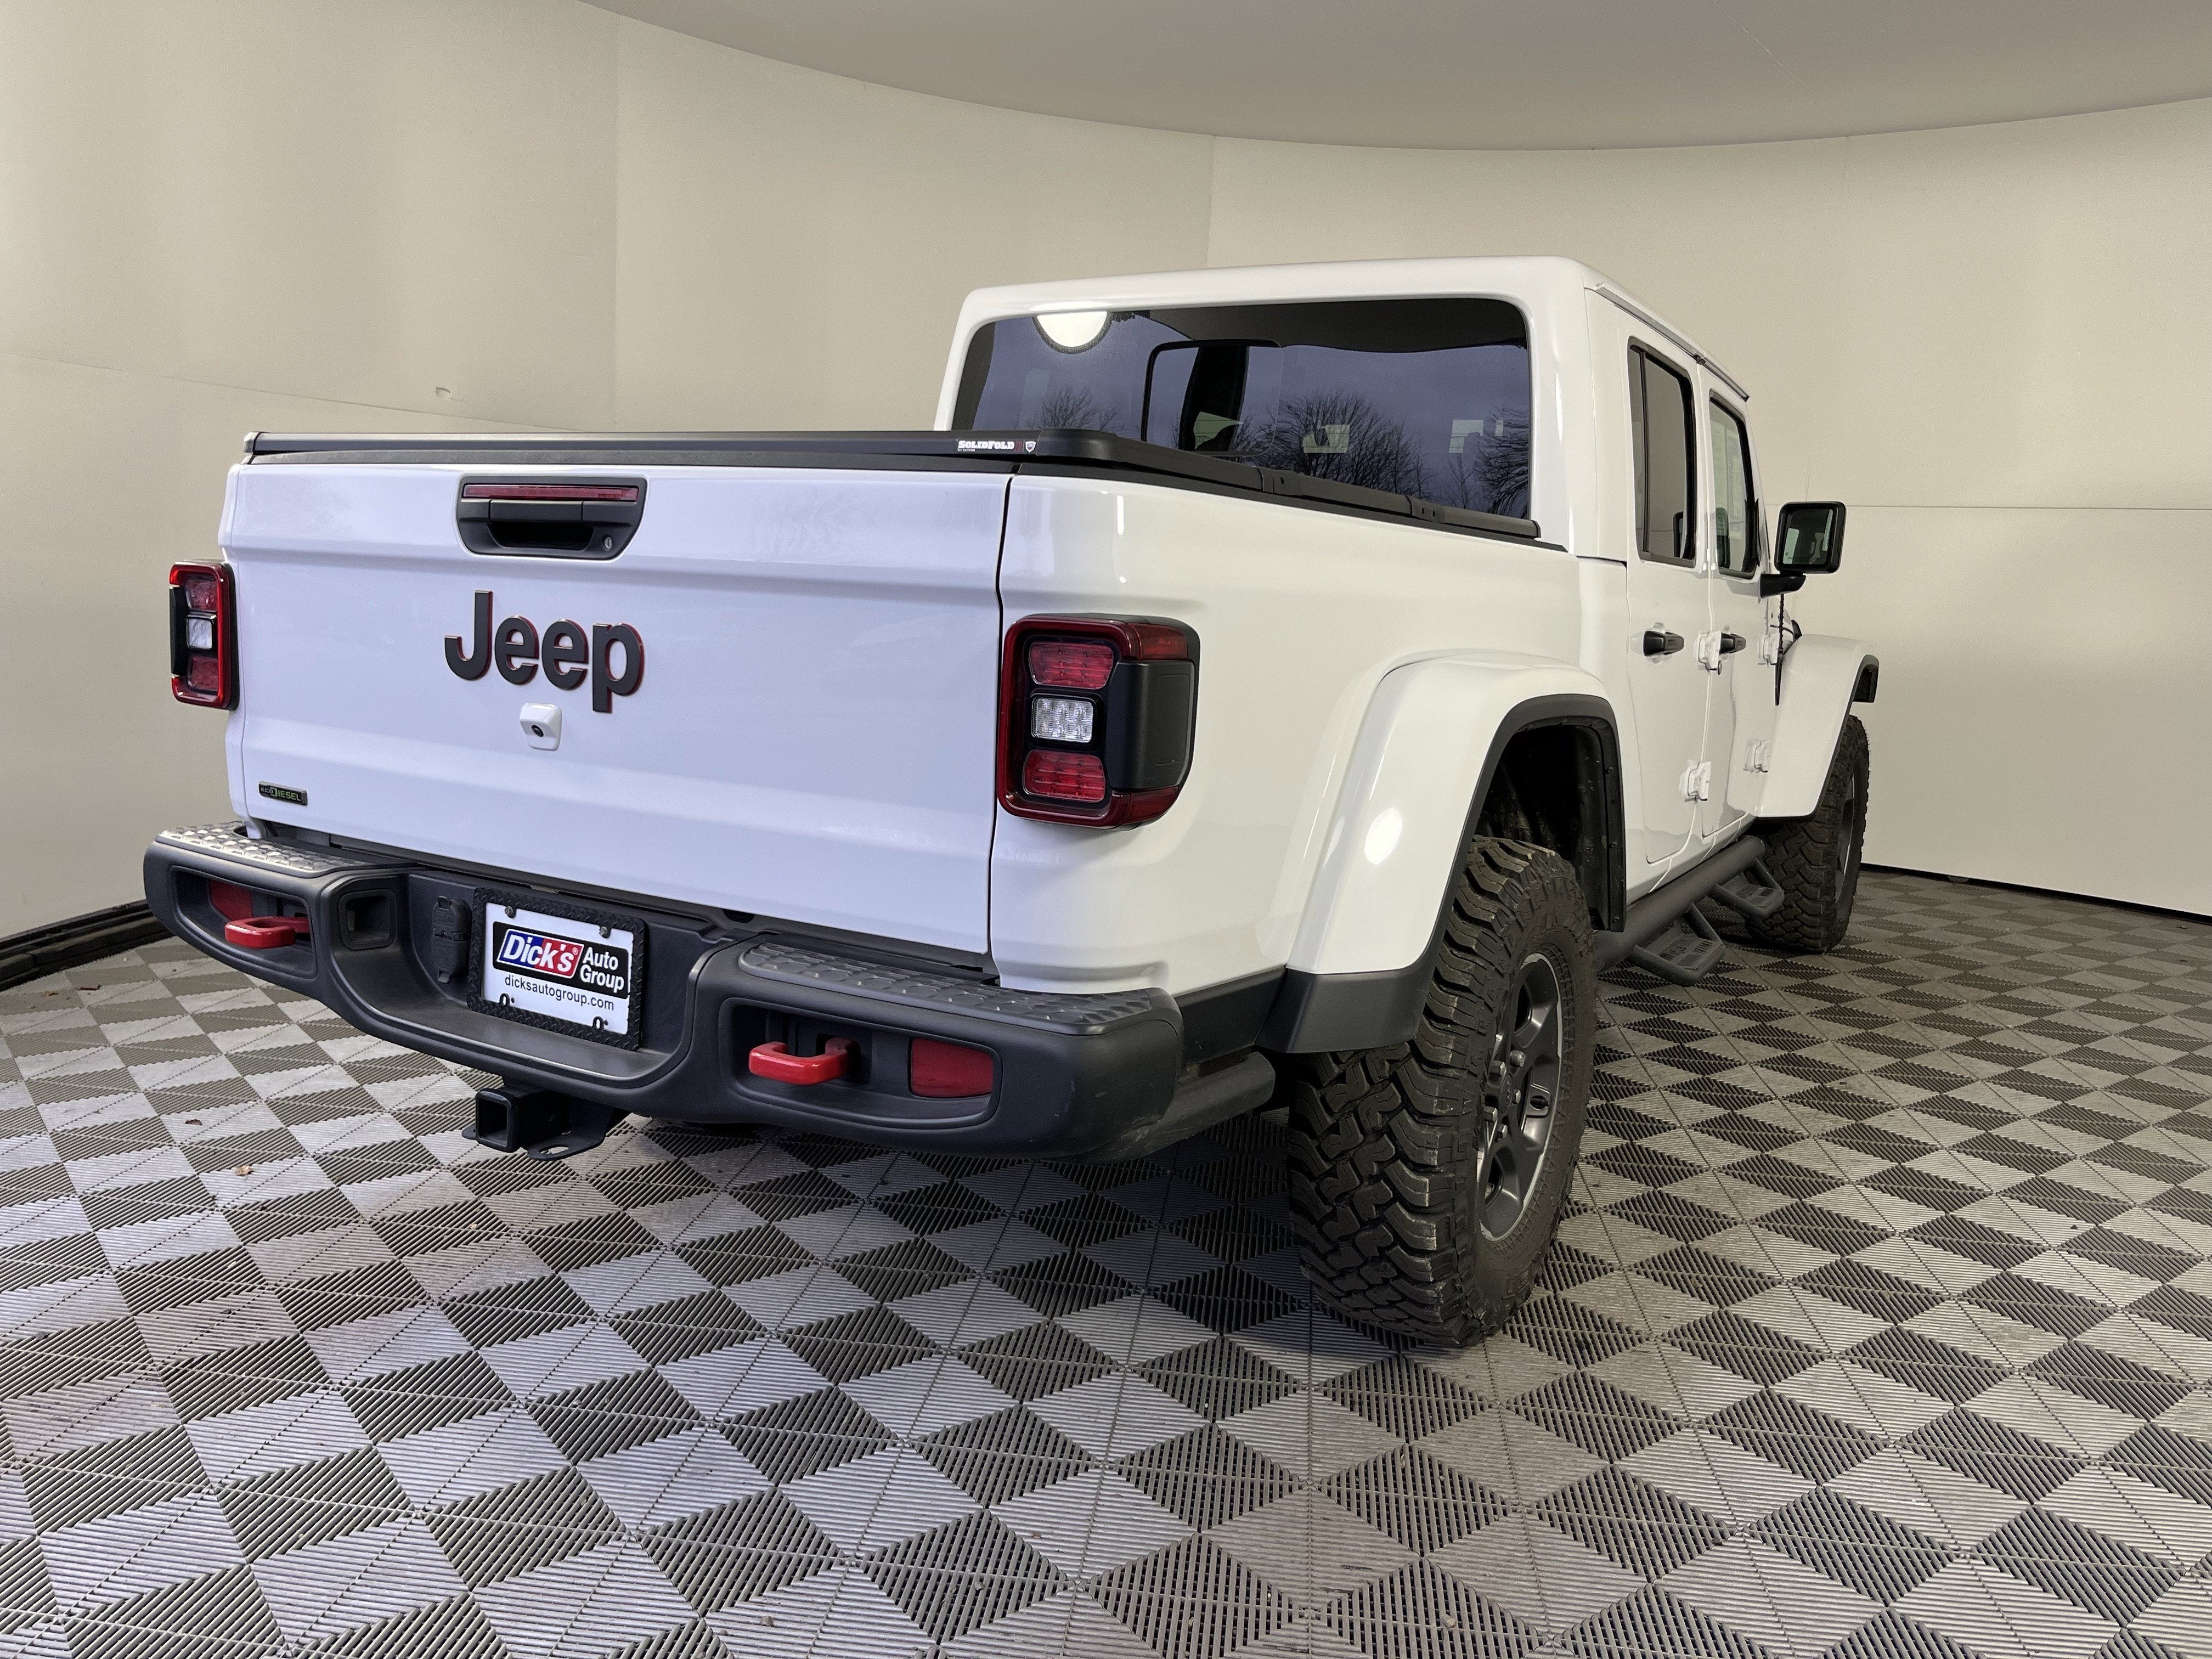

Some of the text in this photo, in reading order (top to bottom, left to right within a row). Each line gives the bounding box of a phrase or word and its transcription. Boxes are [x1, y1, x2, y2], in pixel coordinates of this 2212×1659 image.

[444, 589, 645, 714] Jeep
[583, 946, 619, 970] Auto
[505, 974, 614, 1011] dicksautogroup.com
[580, 964, 624, 994] Group
